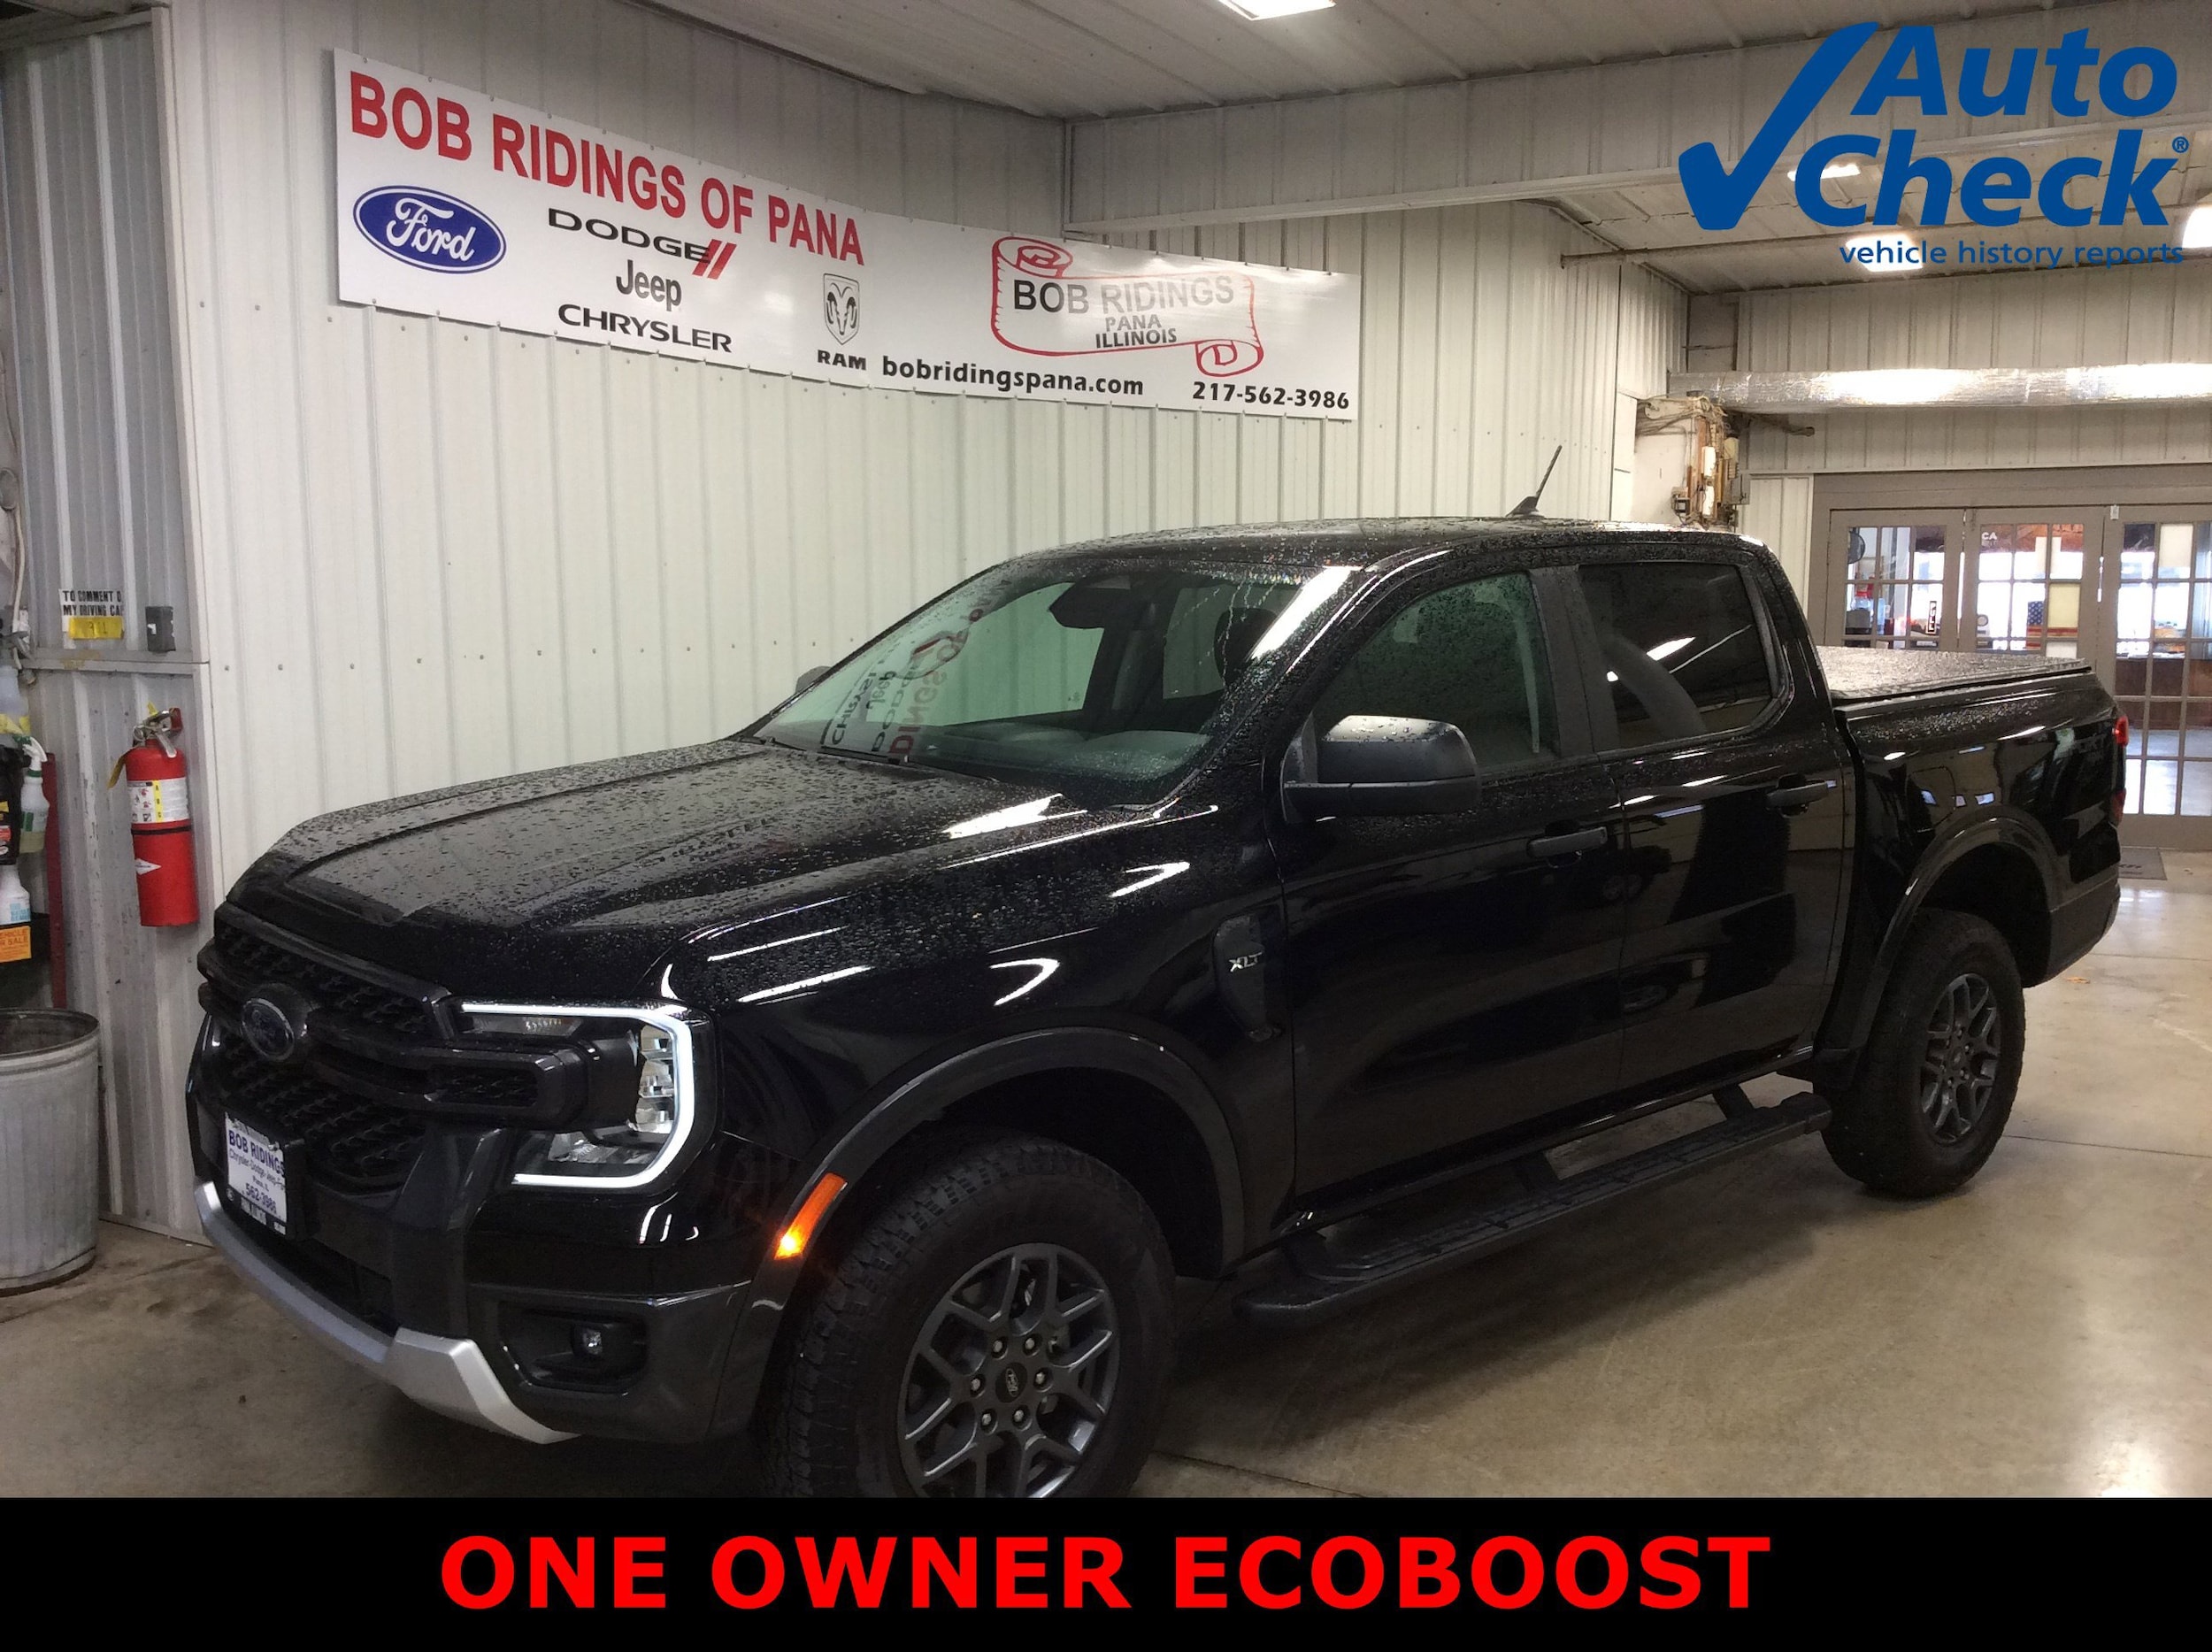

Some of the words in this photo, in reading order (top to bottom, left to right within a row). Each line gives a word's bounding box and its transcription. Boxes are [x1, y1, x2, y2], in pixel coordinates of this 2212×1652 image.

[350, 71, 472, 161] BOB
[493, 112, 687, 219] RIDINGS
[701, 177, 755, 234] OF
[769, 194, 864, 265] PANA
[386, 196, 476, 262] Ford
[549, 208, 710, 264] DODGE
[616, 259, 682, 311] Jeep
[1014, 280, 1089, 313] BOB
[1101, 275, 1234, 314] RIDINGS
[557, 304, 732, 353] CHRYSLER
[1095, 328, 1177, 349] ILLINOIS
[1105, 314, 1162, 332] PANA
[818, 350, 866, 371] RAM
[882, 356, 1144, 396] bobridingspana.com
[1193, 381, 1349, 411] 217-562-3986
[62, 590, 75, 602] TO
[78, 590, 113, 602] COMMENT
[64, 604, 77, 616] MY
[80, 604, 106, 617] DRIVING
[228, 1130, 249, 1153] BOB
